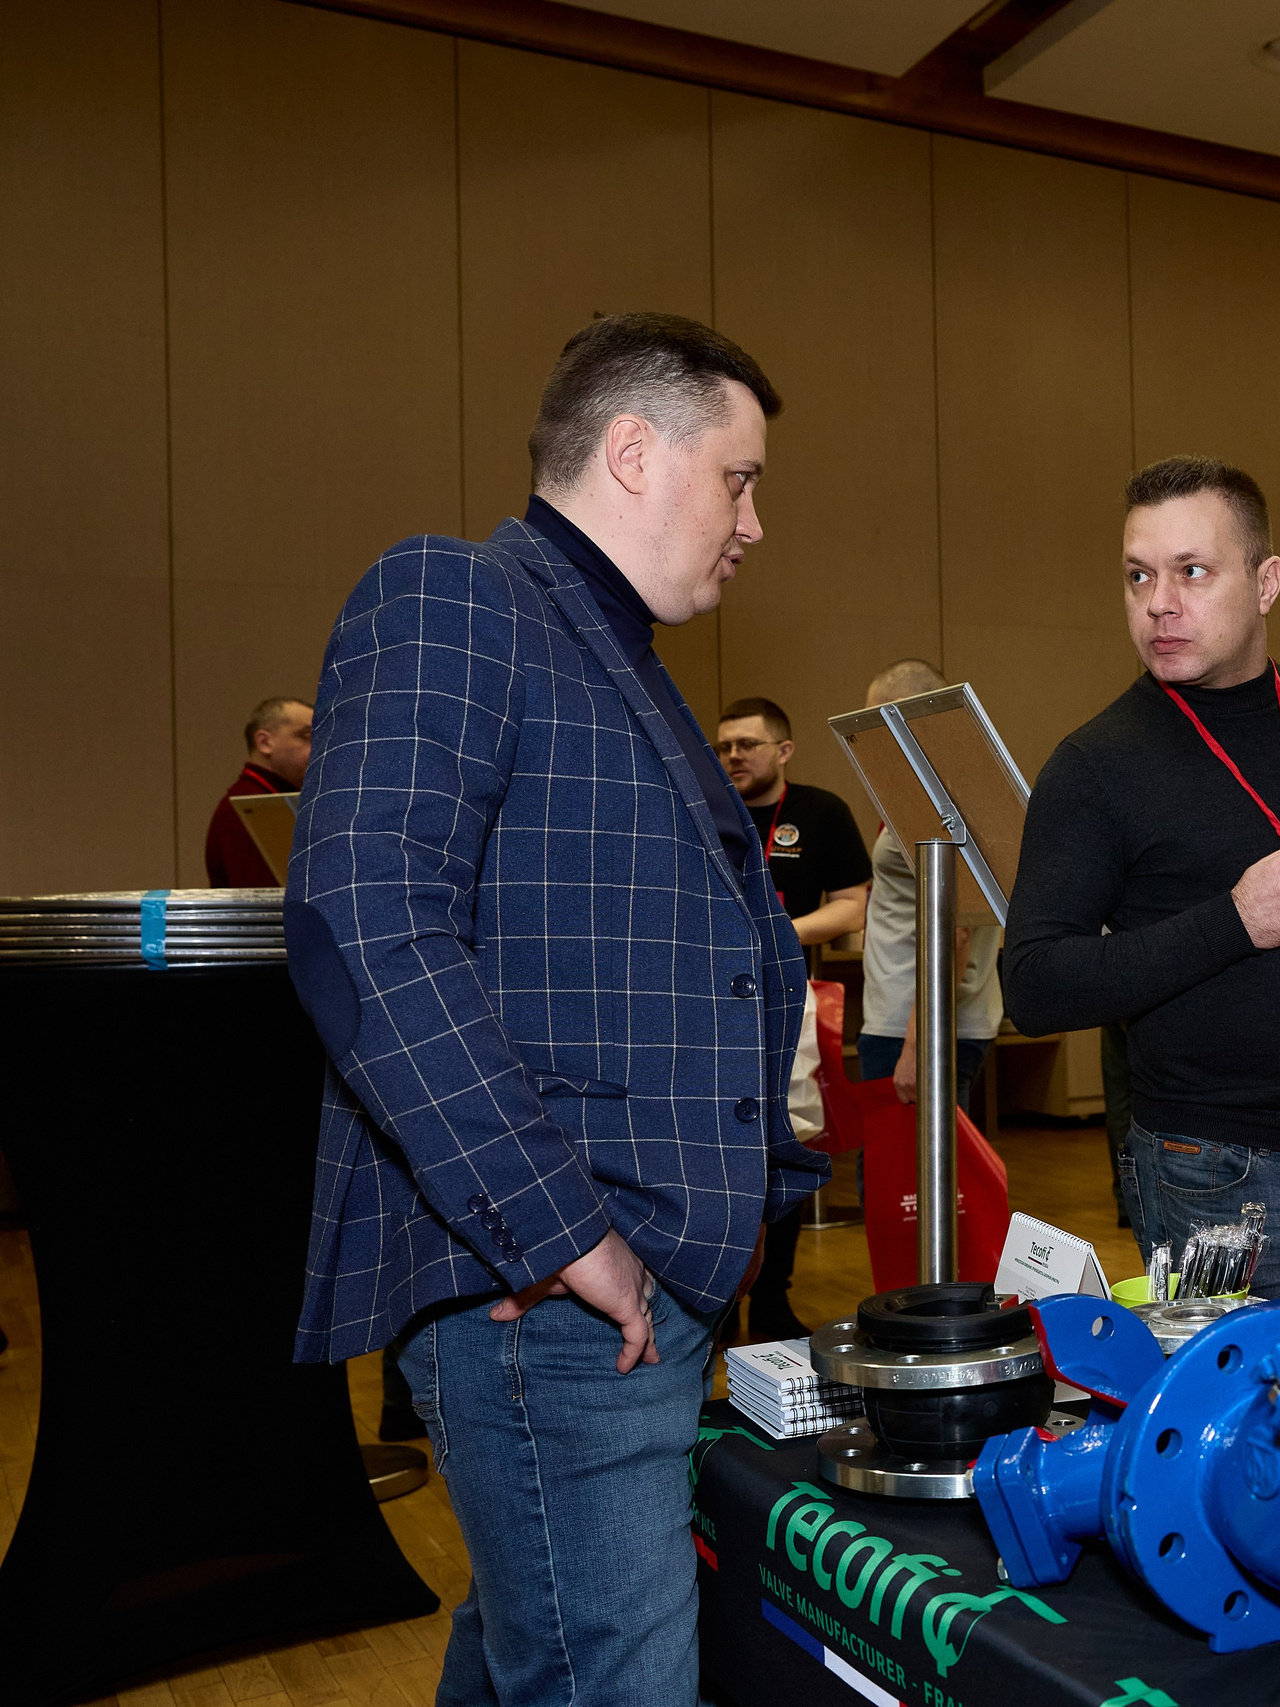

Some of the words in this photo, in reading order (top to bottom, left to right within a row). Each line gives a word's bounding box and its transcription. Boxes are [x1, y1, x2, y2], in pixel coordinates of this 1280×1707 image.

[759, 1563, 794, 1607] VALVE
[797, 1592, 907, 1689] MANUFACTURER
[766, 1482, 962, 1640] Tecofi
